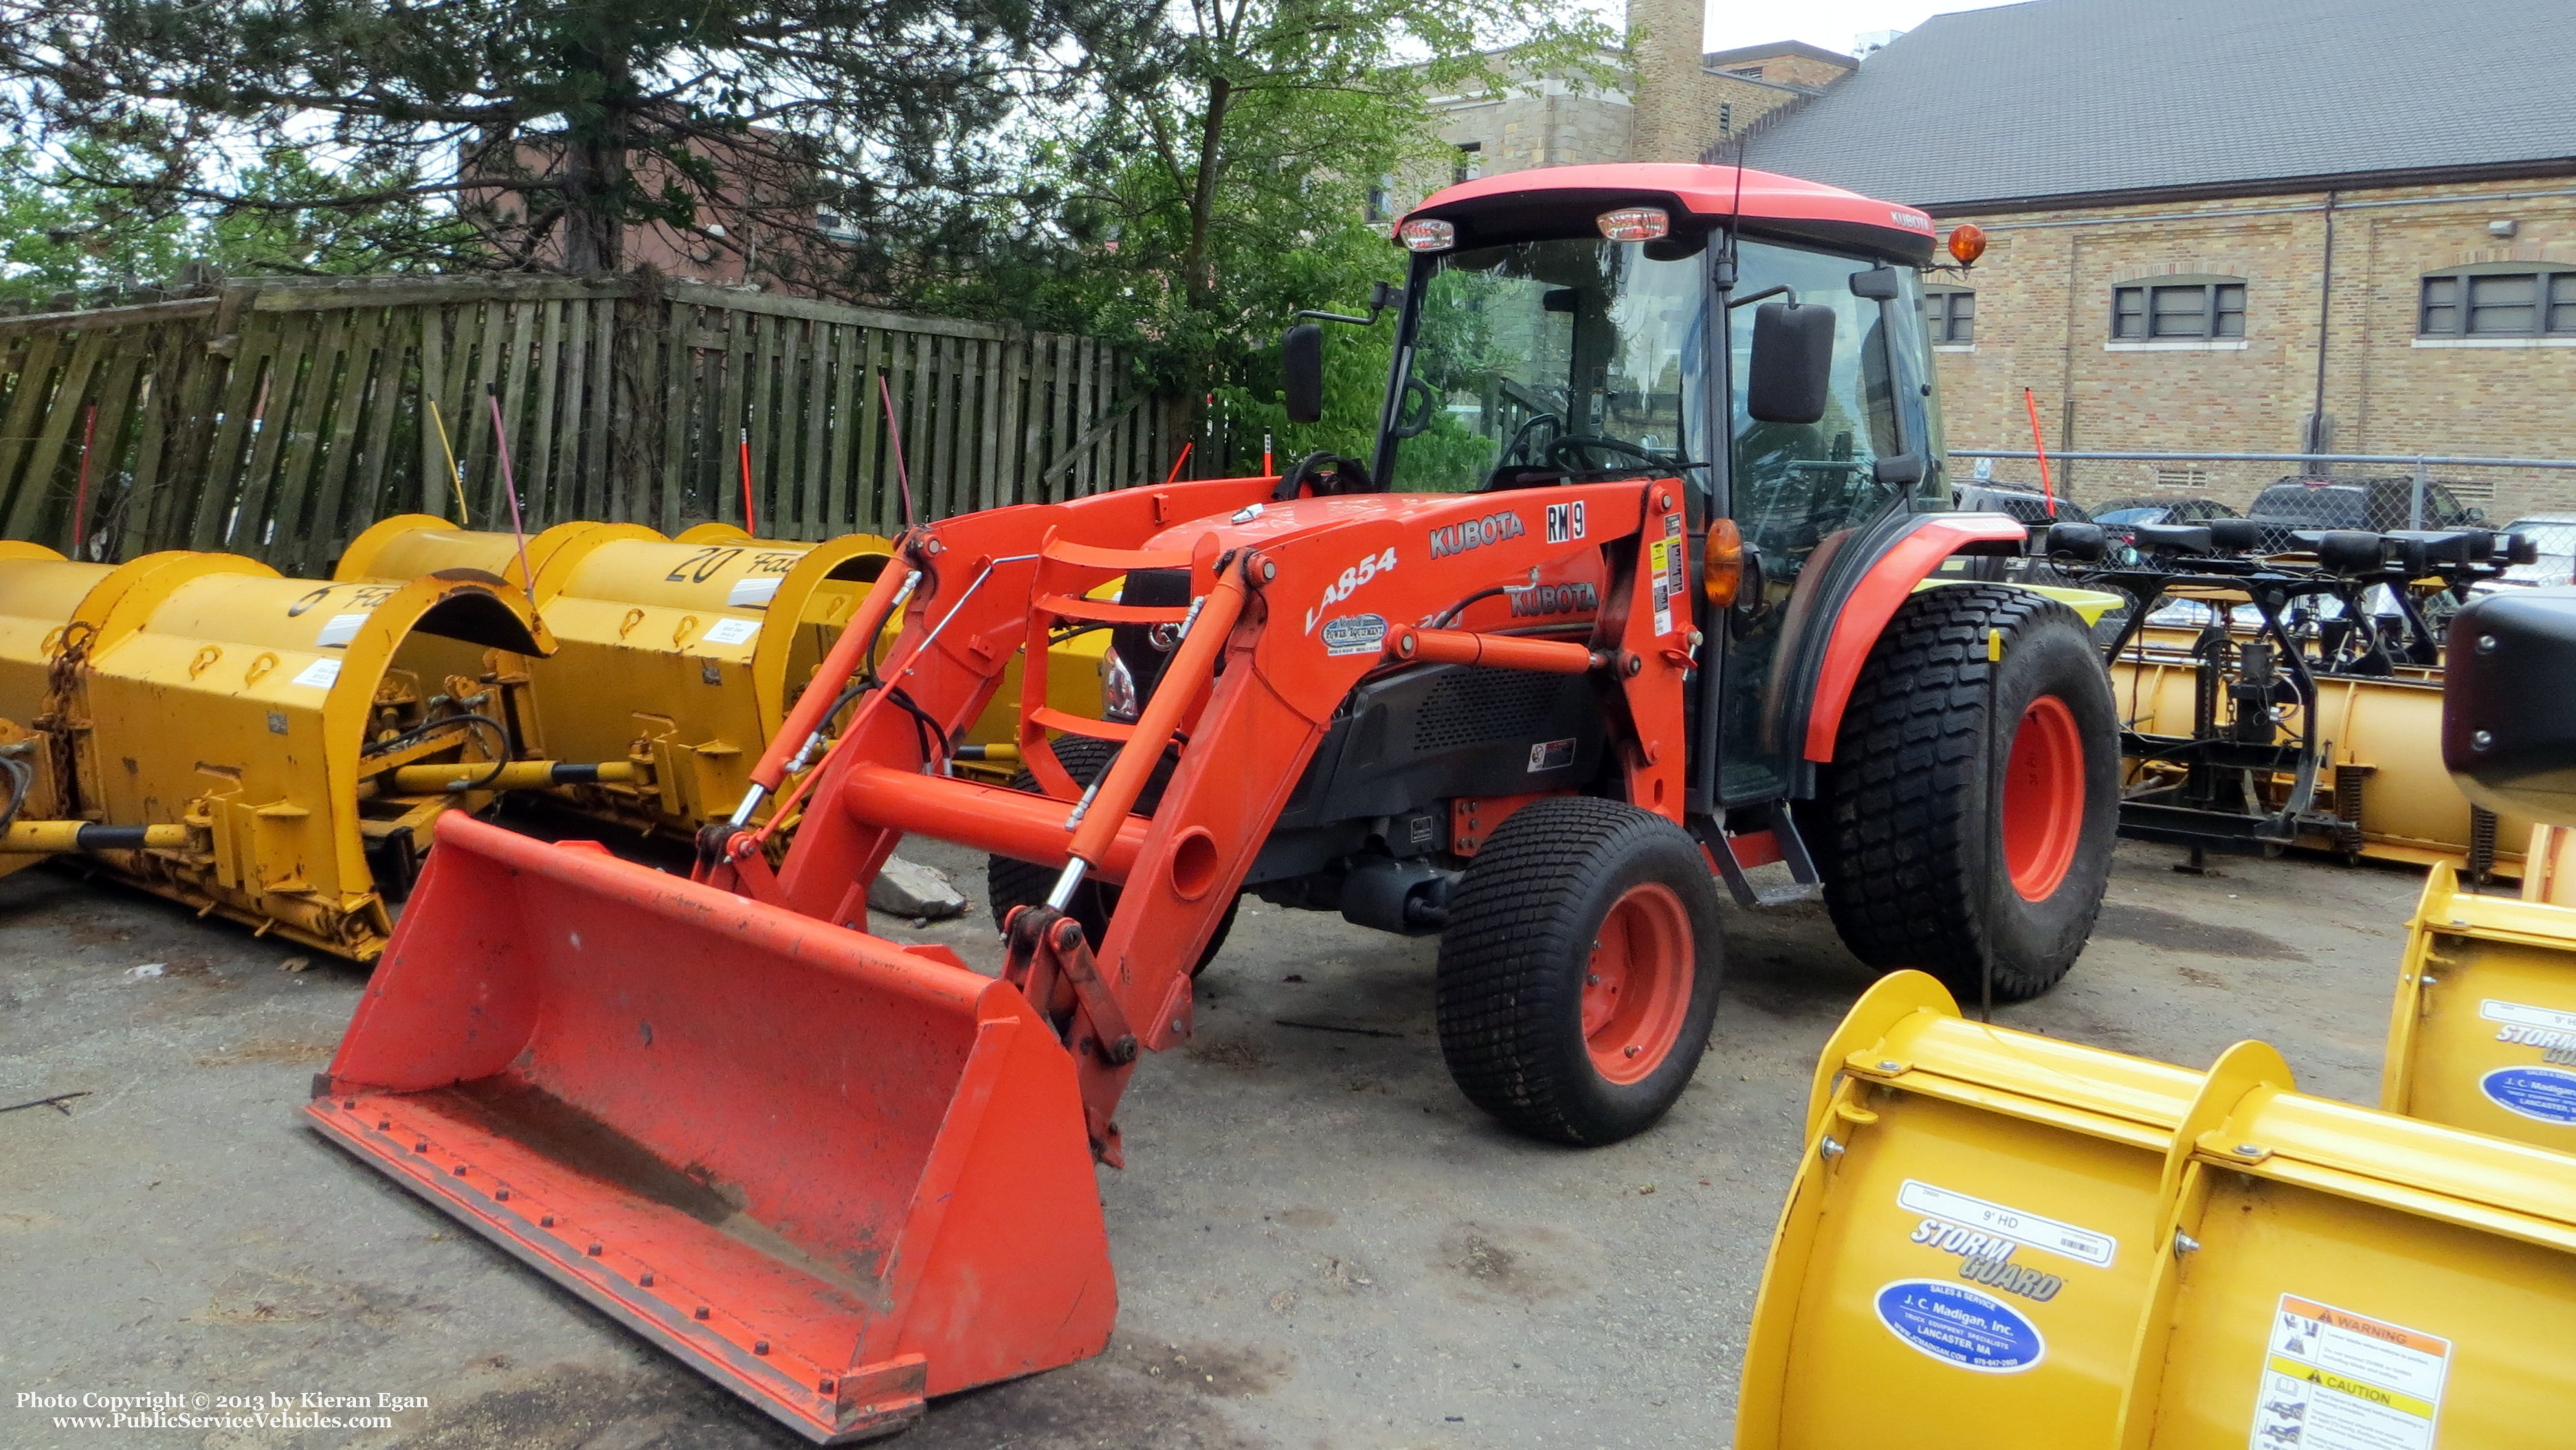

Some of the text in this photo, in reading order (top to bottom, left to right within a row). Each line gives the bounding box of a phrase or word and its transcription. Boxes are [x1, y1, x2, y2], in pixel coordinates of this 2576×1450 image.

[1430, 510, 1525, 560] KUBOTA
[1548, 502, 1584, 542] RM 9
[665, 547, 744, 583] 20
[1305, 546, 1397, 636] LA854
[1510, 583, 1599, 618] KUBOTA
[1997, 1214, 2019, 1229] HD
[1910, 1218, 2017, 1263] STORM
[1959, 1253, 2062, 1302] GUARD
[1905, 1294, 2014, 1337] J. C. Madigan, Inc.
[1930, 1285, 1954, 1297] SALES
[1964, 1293, 1997, 1311] SERVICE
[1905, 1312, 2010, 1350] TRUCK EQUIPMENT SPECIALISTS
[1918, 1325, 1991, 1356] LANCASTER, MA
[2338, 1315, 2407, 1345] WARNING
[2327, 1376, 2391, 1405] CAUTION
